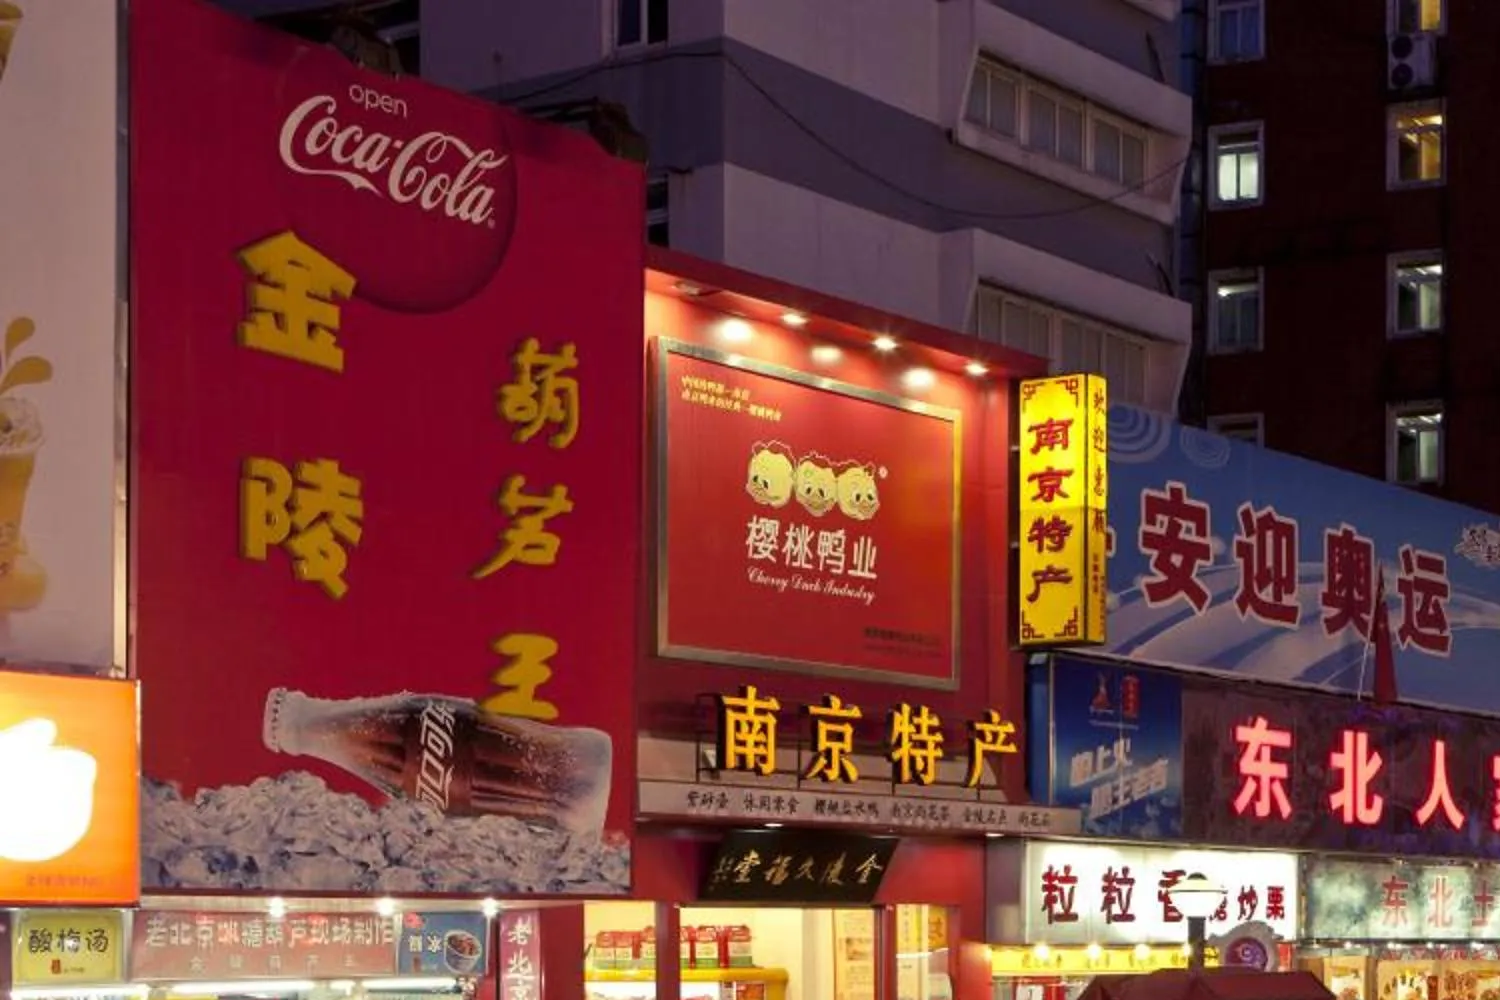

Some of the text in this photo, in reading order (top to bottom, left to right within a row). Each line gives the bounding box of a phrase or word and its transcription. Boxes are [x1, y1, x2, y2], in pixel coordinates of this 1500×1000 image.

[350, 84, 408, 118] open
[279, 95, 508, 225] Coca-Cola
[237, 230, 364, 600] 金陵
[472, 337, 581, 719] 葫芦王
[745, 514, 877, 579] 樱桃鸭业
[1027, 416, 1075, 603] 南京特产
[747, 566, 788, 593] Cherry
[823, 579, 876, 605] Industry
[1104, 481, 1451, 656] 安迎奥运
[721, 685, 1018, 788] 南京特产
[28, 927, 109, 953] 酸梅汤
